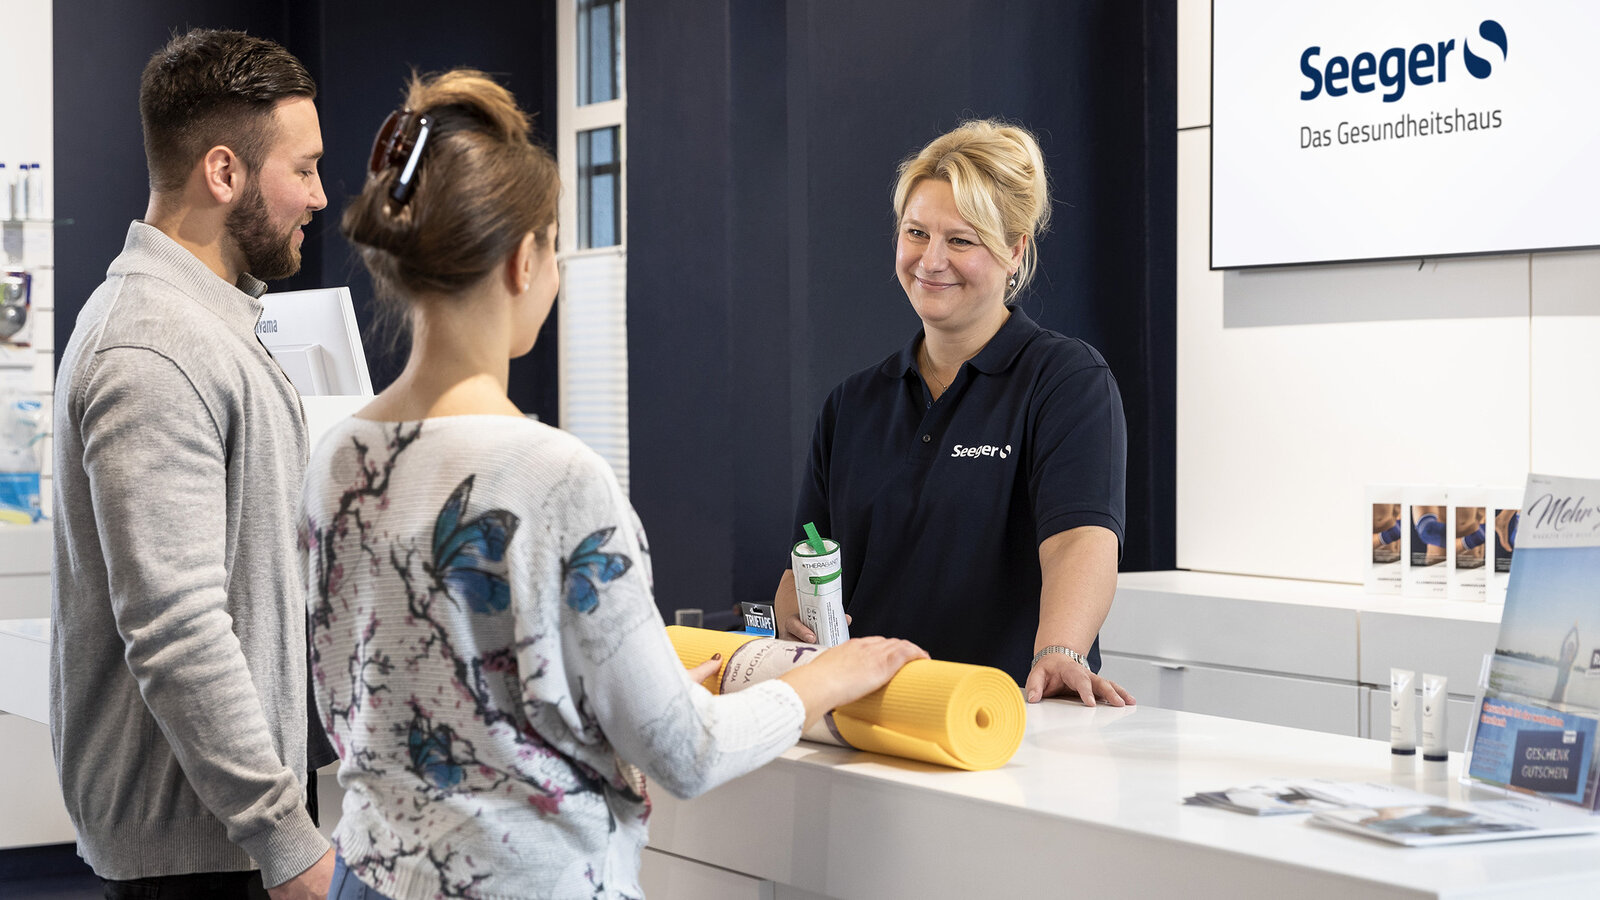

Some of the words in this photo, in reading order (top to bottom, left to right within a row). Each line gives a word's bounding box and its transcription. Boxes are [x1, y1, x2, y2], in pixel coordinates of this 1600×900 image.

[1300, 38, 1455, 103] Seeger
[1300, 125, 1332, 149] Das
[1337, 107, 1502, 145] Gesundheitshaus
[950, 444, 999, 459] Seeger
[1528, 493, 1593, 531] Mehr
[745, 613, 773, 630] TRUETAPE
[730, 663, 741, 682] YOGI
[1525, 747, 1570, 761] GESCHENK
[1521, 765, 1570, 780] GUTSCHEIN
